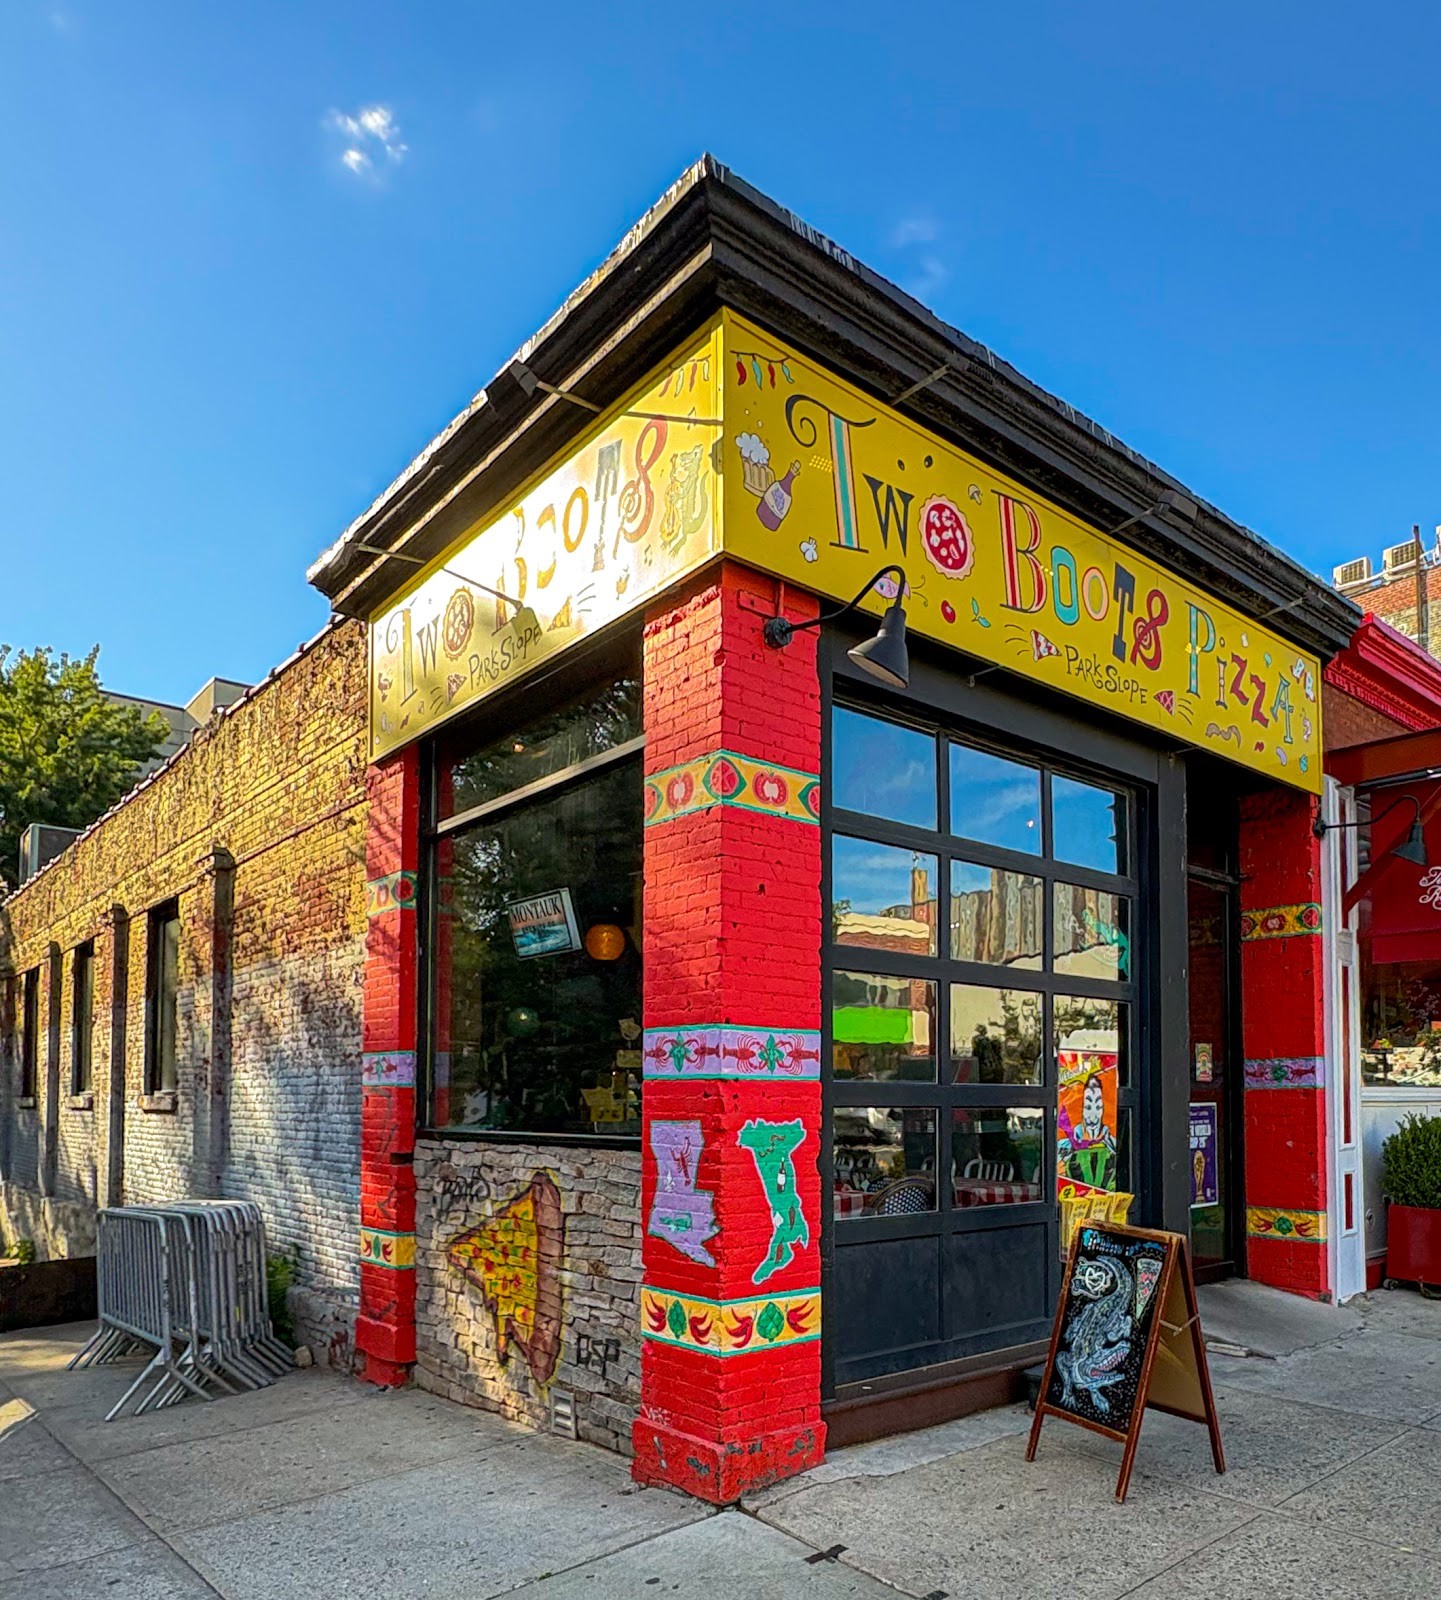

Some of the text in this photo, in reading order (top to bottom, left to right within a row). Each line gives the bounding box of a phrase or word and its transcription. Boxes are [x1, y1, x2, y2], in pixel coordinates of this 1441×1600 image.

[785, 394, 975, 581] TWO
[468, 625, 542, 691] PARK SLOPE
[1065, 645, 1148, 704] PARK SLOPE
